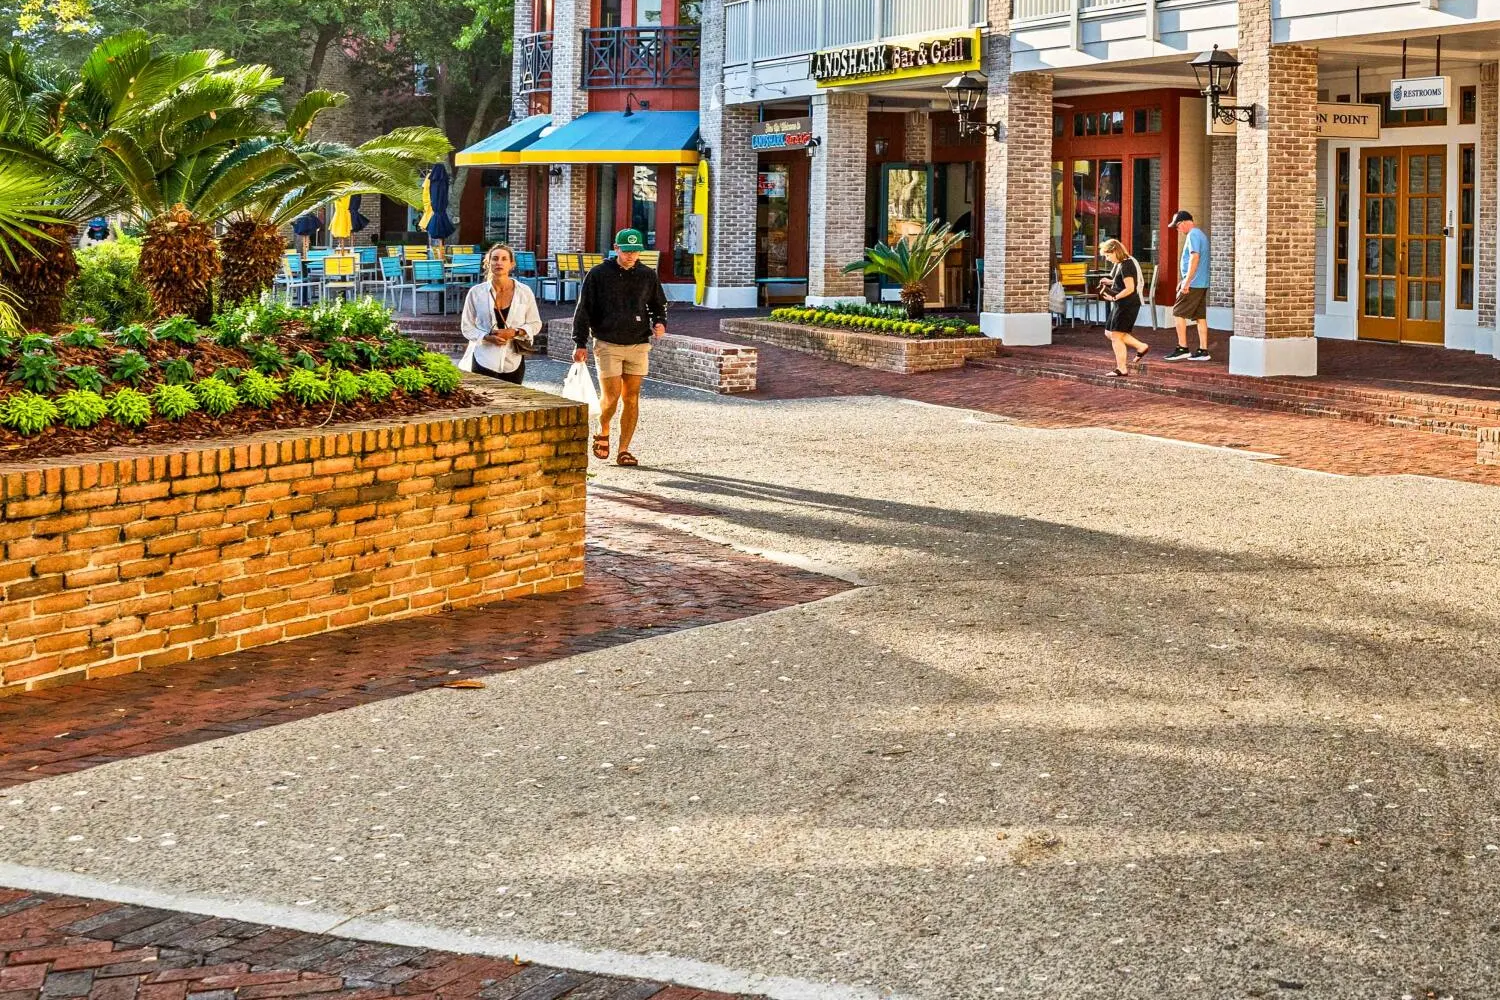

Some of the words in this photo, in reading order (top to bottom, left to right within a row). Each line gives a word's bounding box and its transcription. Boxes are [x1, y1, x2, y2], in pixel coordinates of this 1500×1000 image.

[808, 44, 887, 81] LANDSHARK
[892, 46, 914, 69] Bar
[917, 42, 928, 67] &
[931, 37, 965, 64] Grill
[1403, 87, 1442, 98] RESTROOMS
[1333, 113, 1369, 125] POINT
